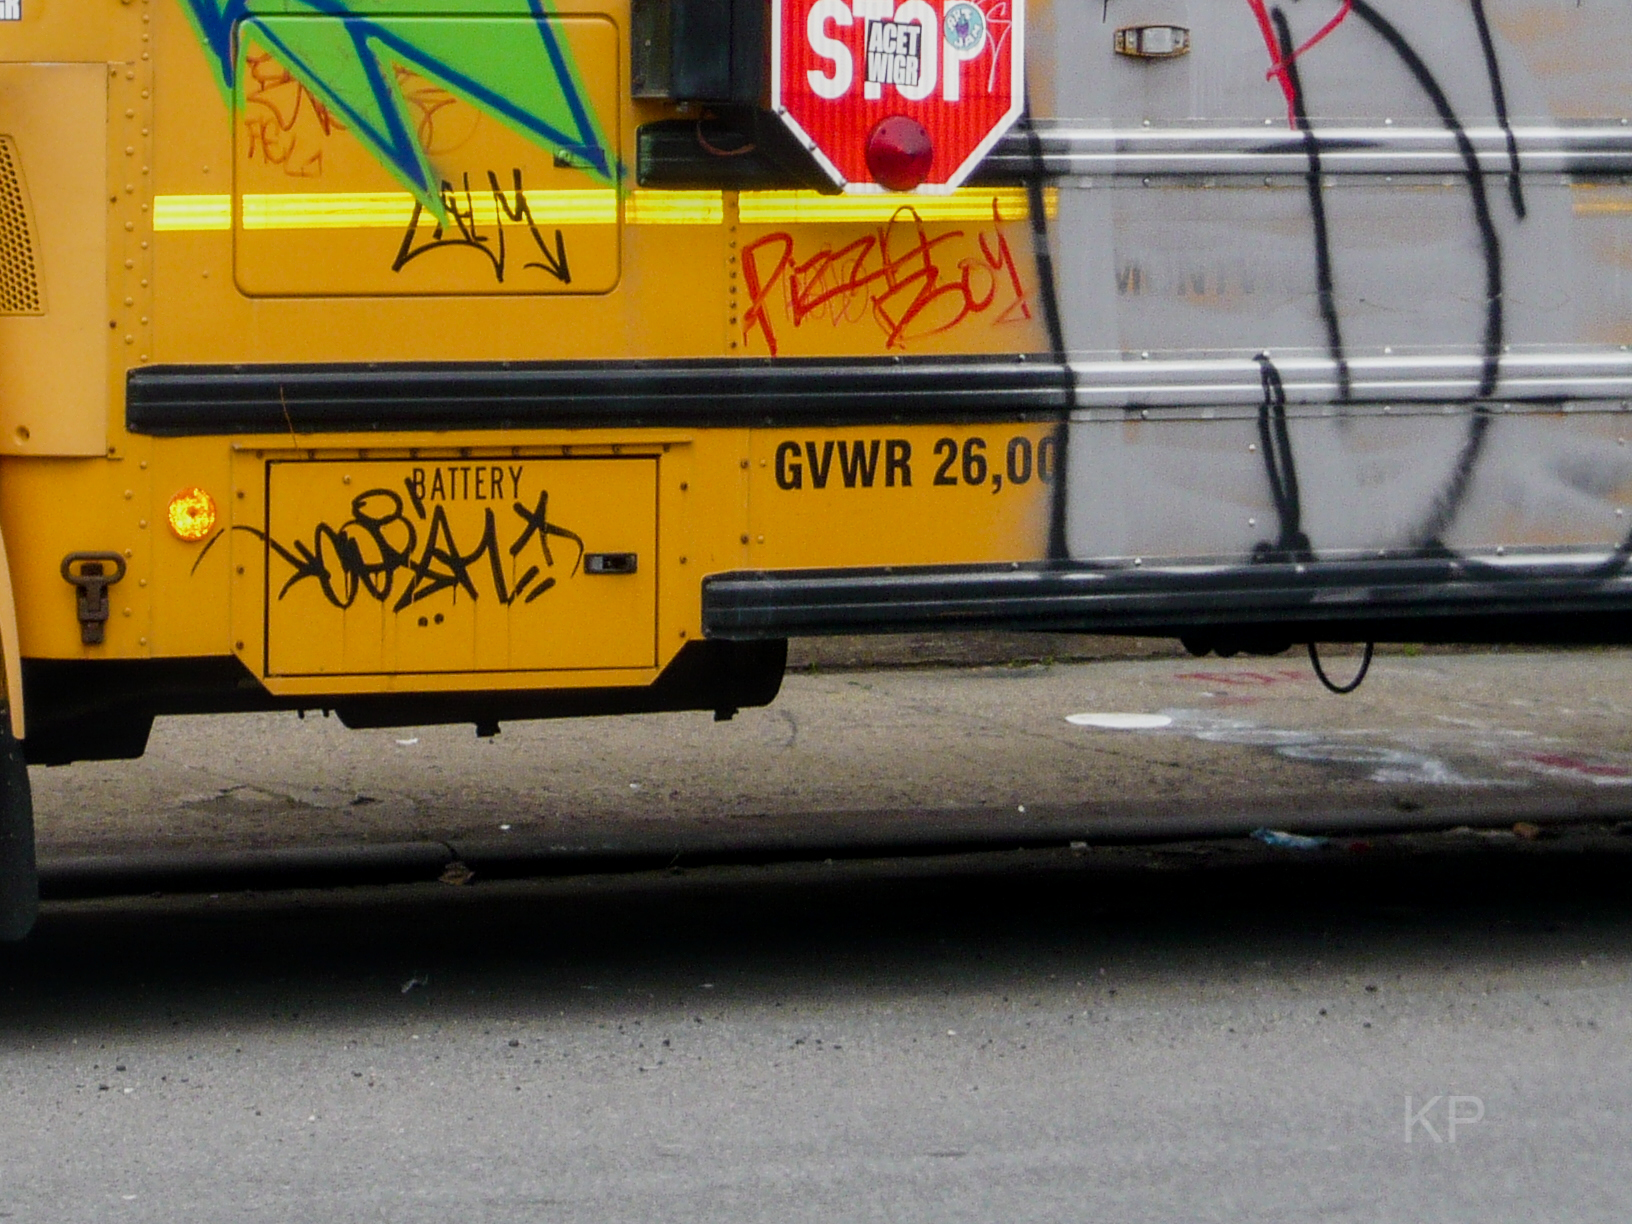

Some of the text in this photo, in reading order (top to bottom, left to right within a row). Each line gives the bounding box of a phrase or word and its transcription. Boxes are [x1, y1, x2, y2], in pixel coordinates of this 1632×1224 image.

[868, 22, 921, 57] ACET
[867, 52, 920, 87] WIGR
[774, 438, 913, 491] GVWR
[412, 466, 524, 502] BATTERY
